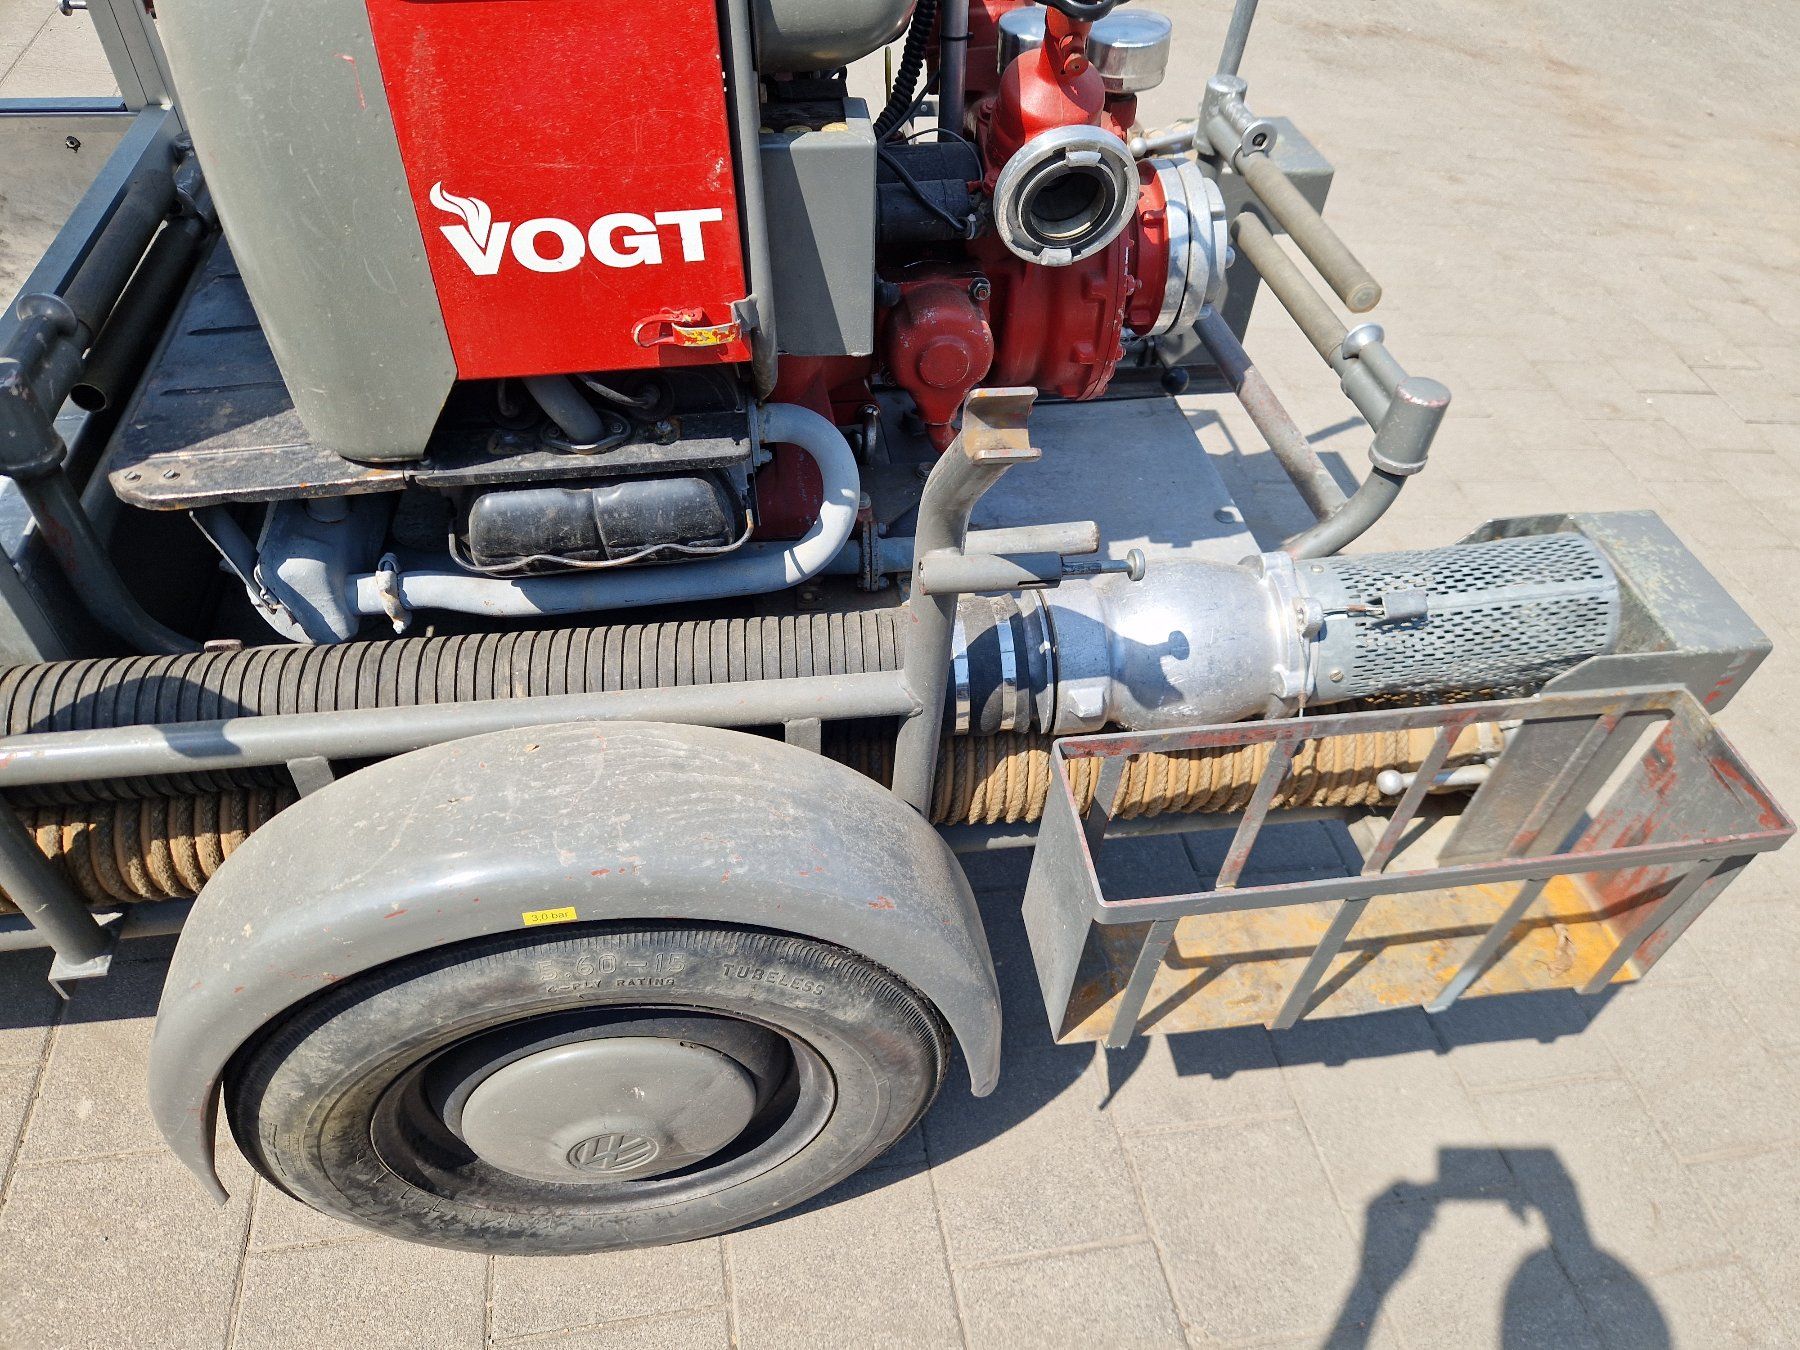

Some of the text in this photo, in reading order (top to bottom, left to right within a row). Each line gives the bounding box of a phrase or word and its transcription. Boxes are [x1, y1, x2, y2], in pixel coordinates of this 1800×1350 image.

[439, 207, 723, 276] VOGT
[551, 911, 570, 919] bar
[616, 977, 676, 987] RATING
[722, 963, 826, 996] TUBELESS
